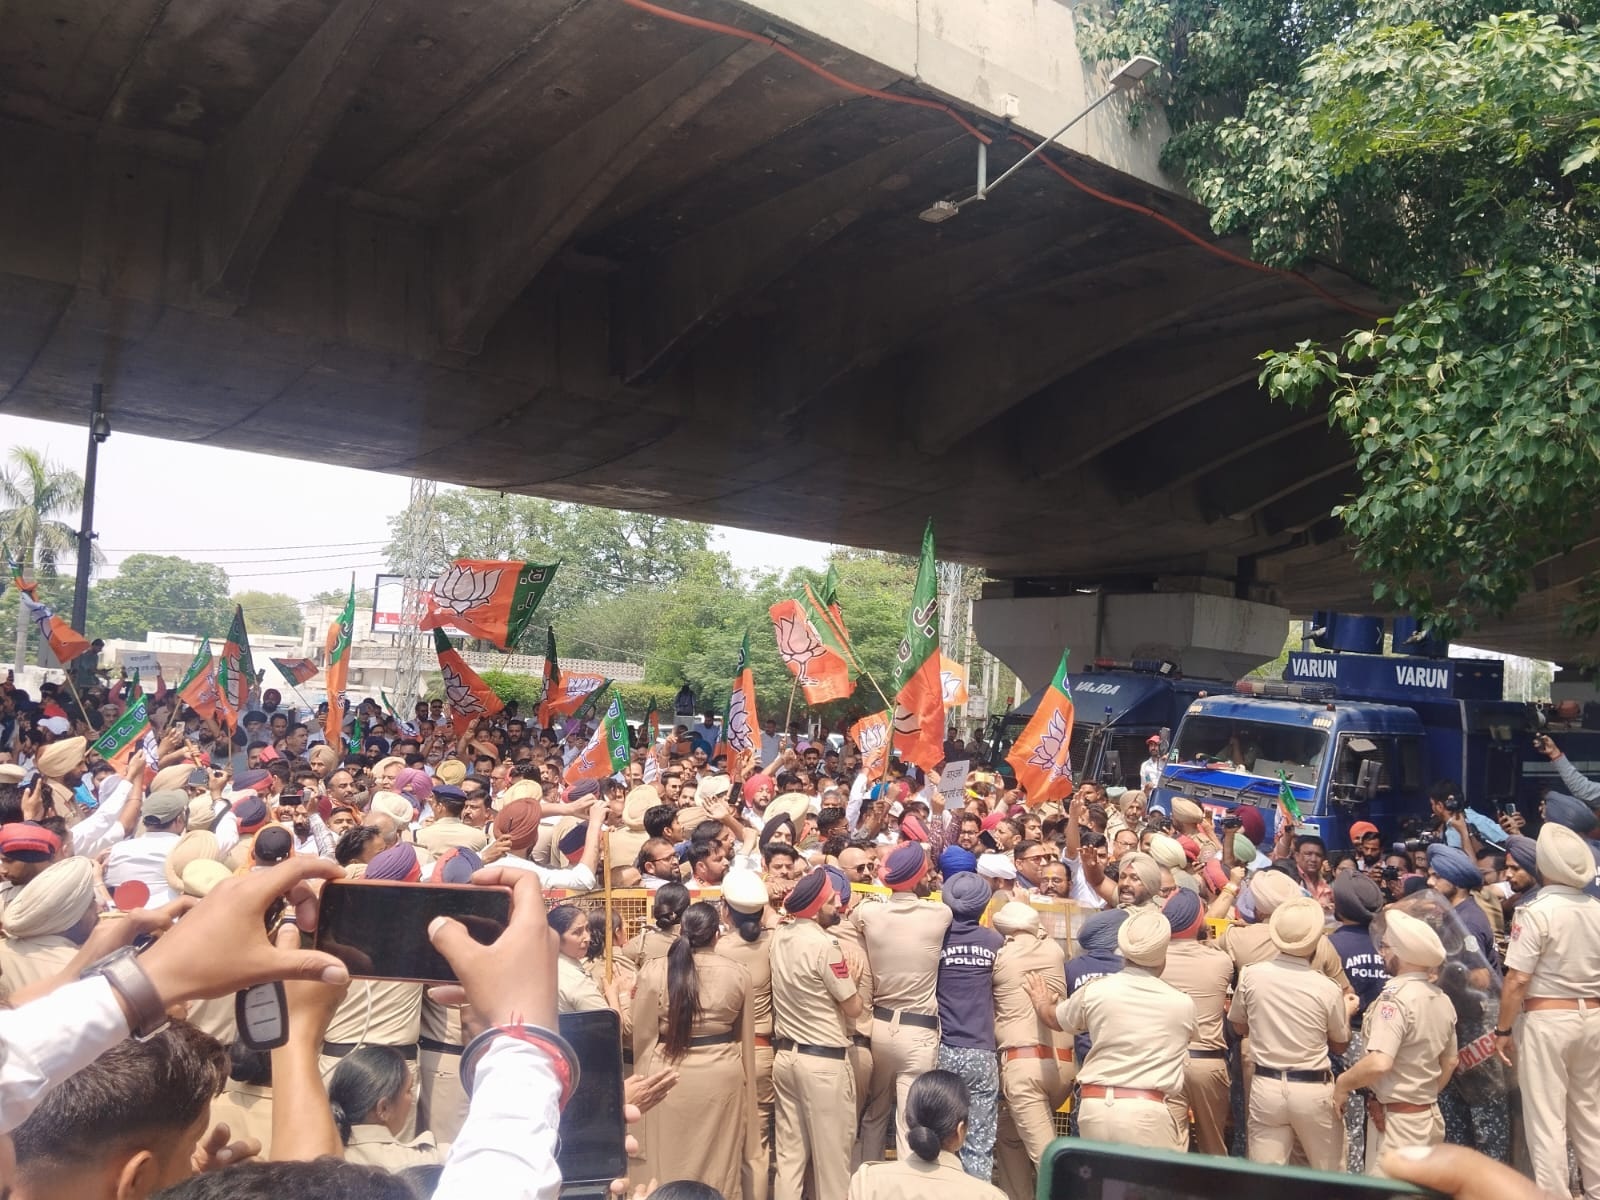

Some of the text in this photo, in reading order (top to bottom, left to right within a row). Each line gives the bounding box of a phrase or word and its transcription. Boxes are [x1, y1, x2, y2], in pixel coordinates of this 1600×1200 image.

[1292, 658, 1337, 679] VARUN
[1396, 665, 1449, 689] VARUN
[1075, 681, 1120, 695] VAJRA
[98, 702, 148, 750] BJP
[940, 945, 968, 958] ANTI
[945, 957, 993, 966] POLICE
[1345, 953, 1372, 970] ANTI
